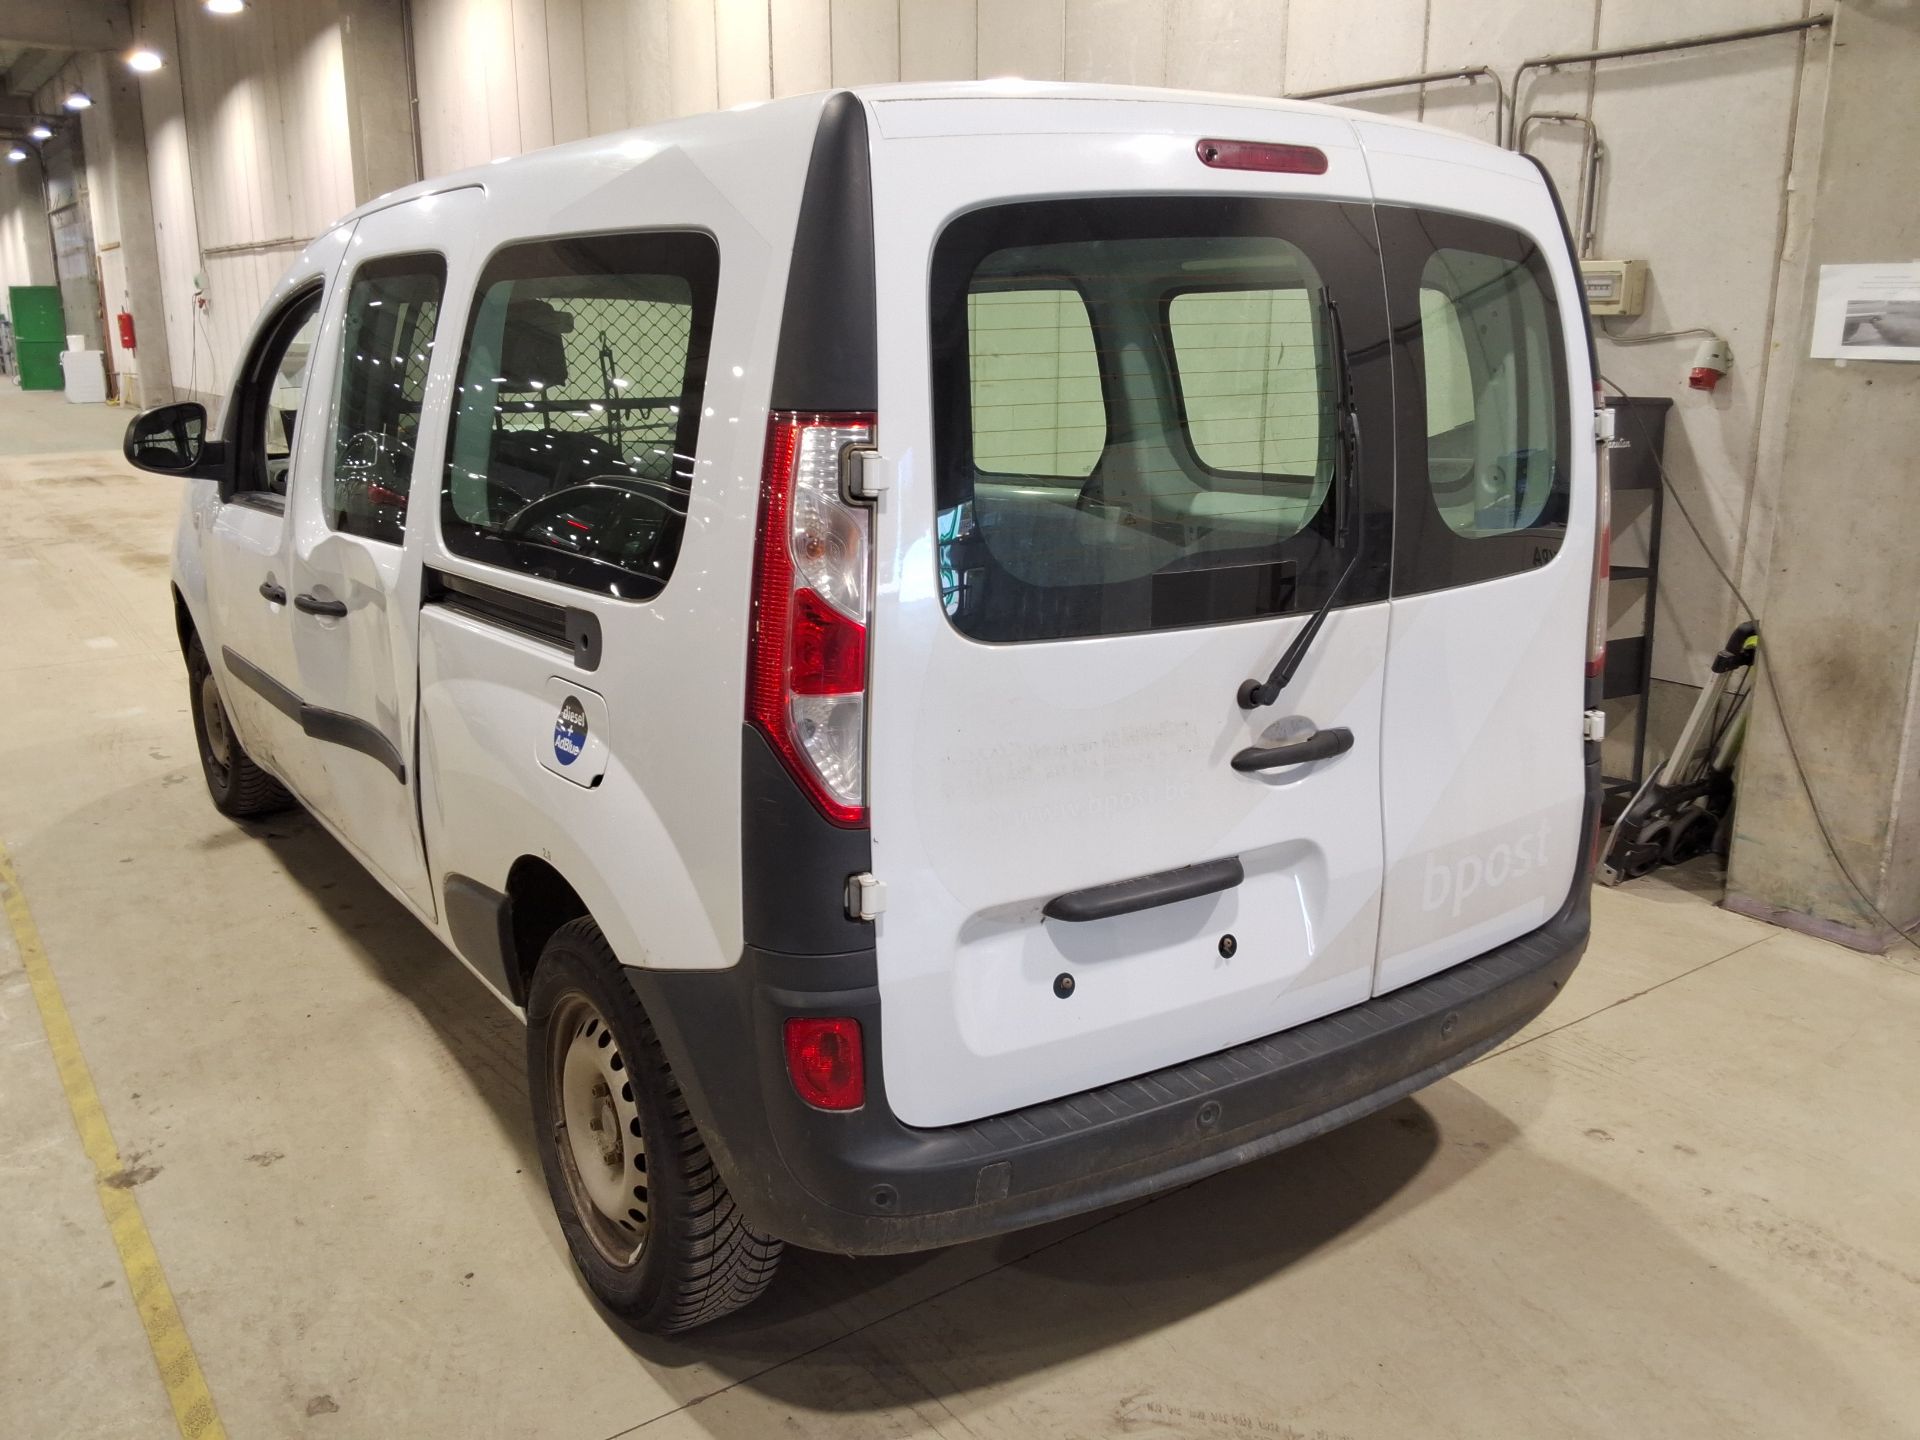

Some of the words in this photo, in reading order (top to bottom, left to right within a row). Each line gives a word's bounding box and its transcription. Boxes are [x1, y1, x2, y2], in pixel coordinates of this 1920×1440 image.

[562, 705, 586, 727] diesel
[554, 734, 581, 756] AdBlue
[1421, 816, 1553, 918] bpost
